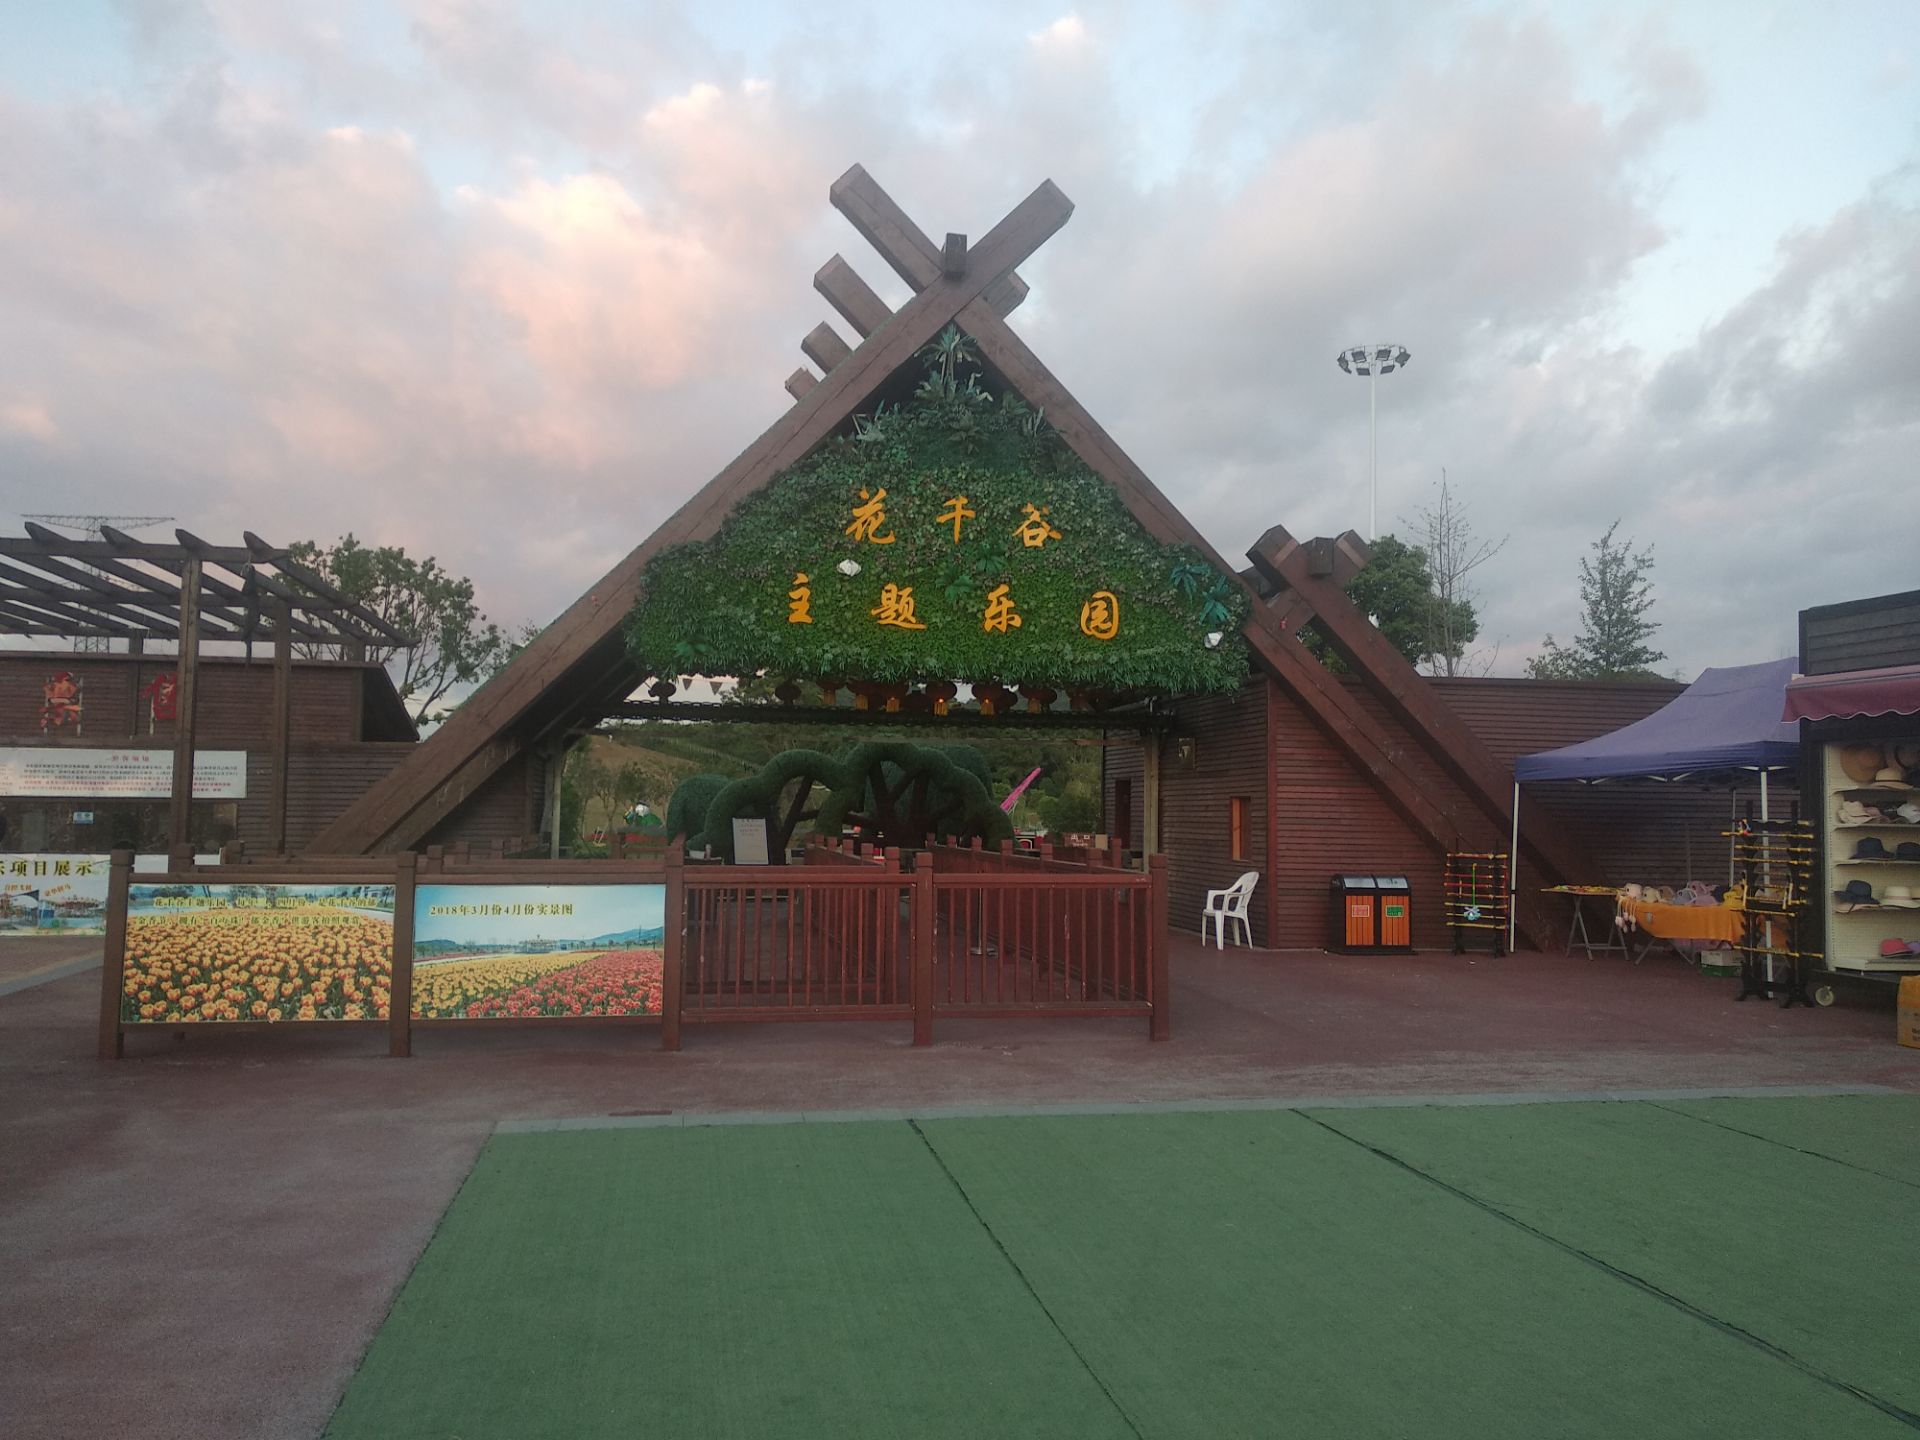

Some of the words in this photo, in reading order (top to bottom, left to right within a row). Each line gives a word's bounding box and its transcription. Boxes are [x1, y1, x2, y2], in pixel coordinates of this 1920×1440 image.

[844, 488, 1062, 549] 花千谷
[788, 572, 1121, 641] 主题乐园
[430, 903, 573, 916] 2018年3月份4月份实景图
